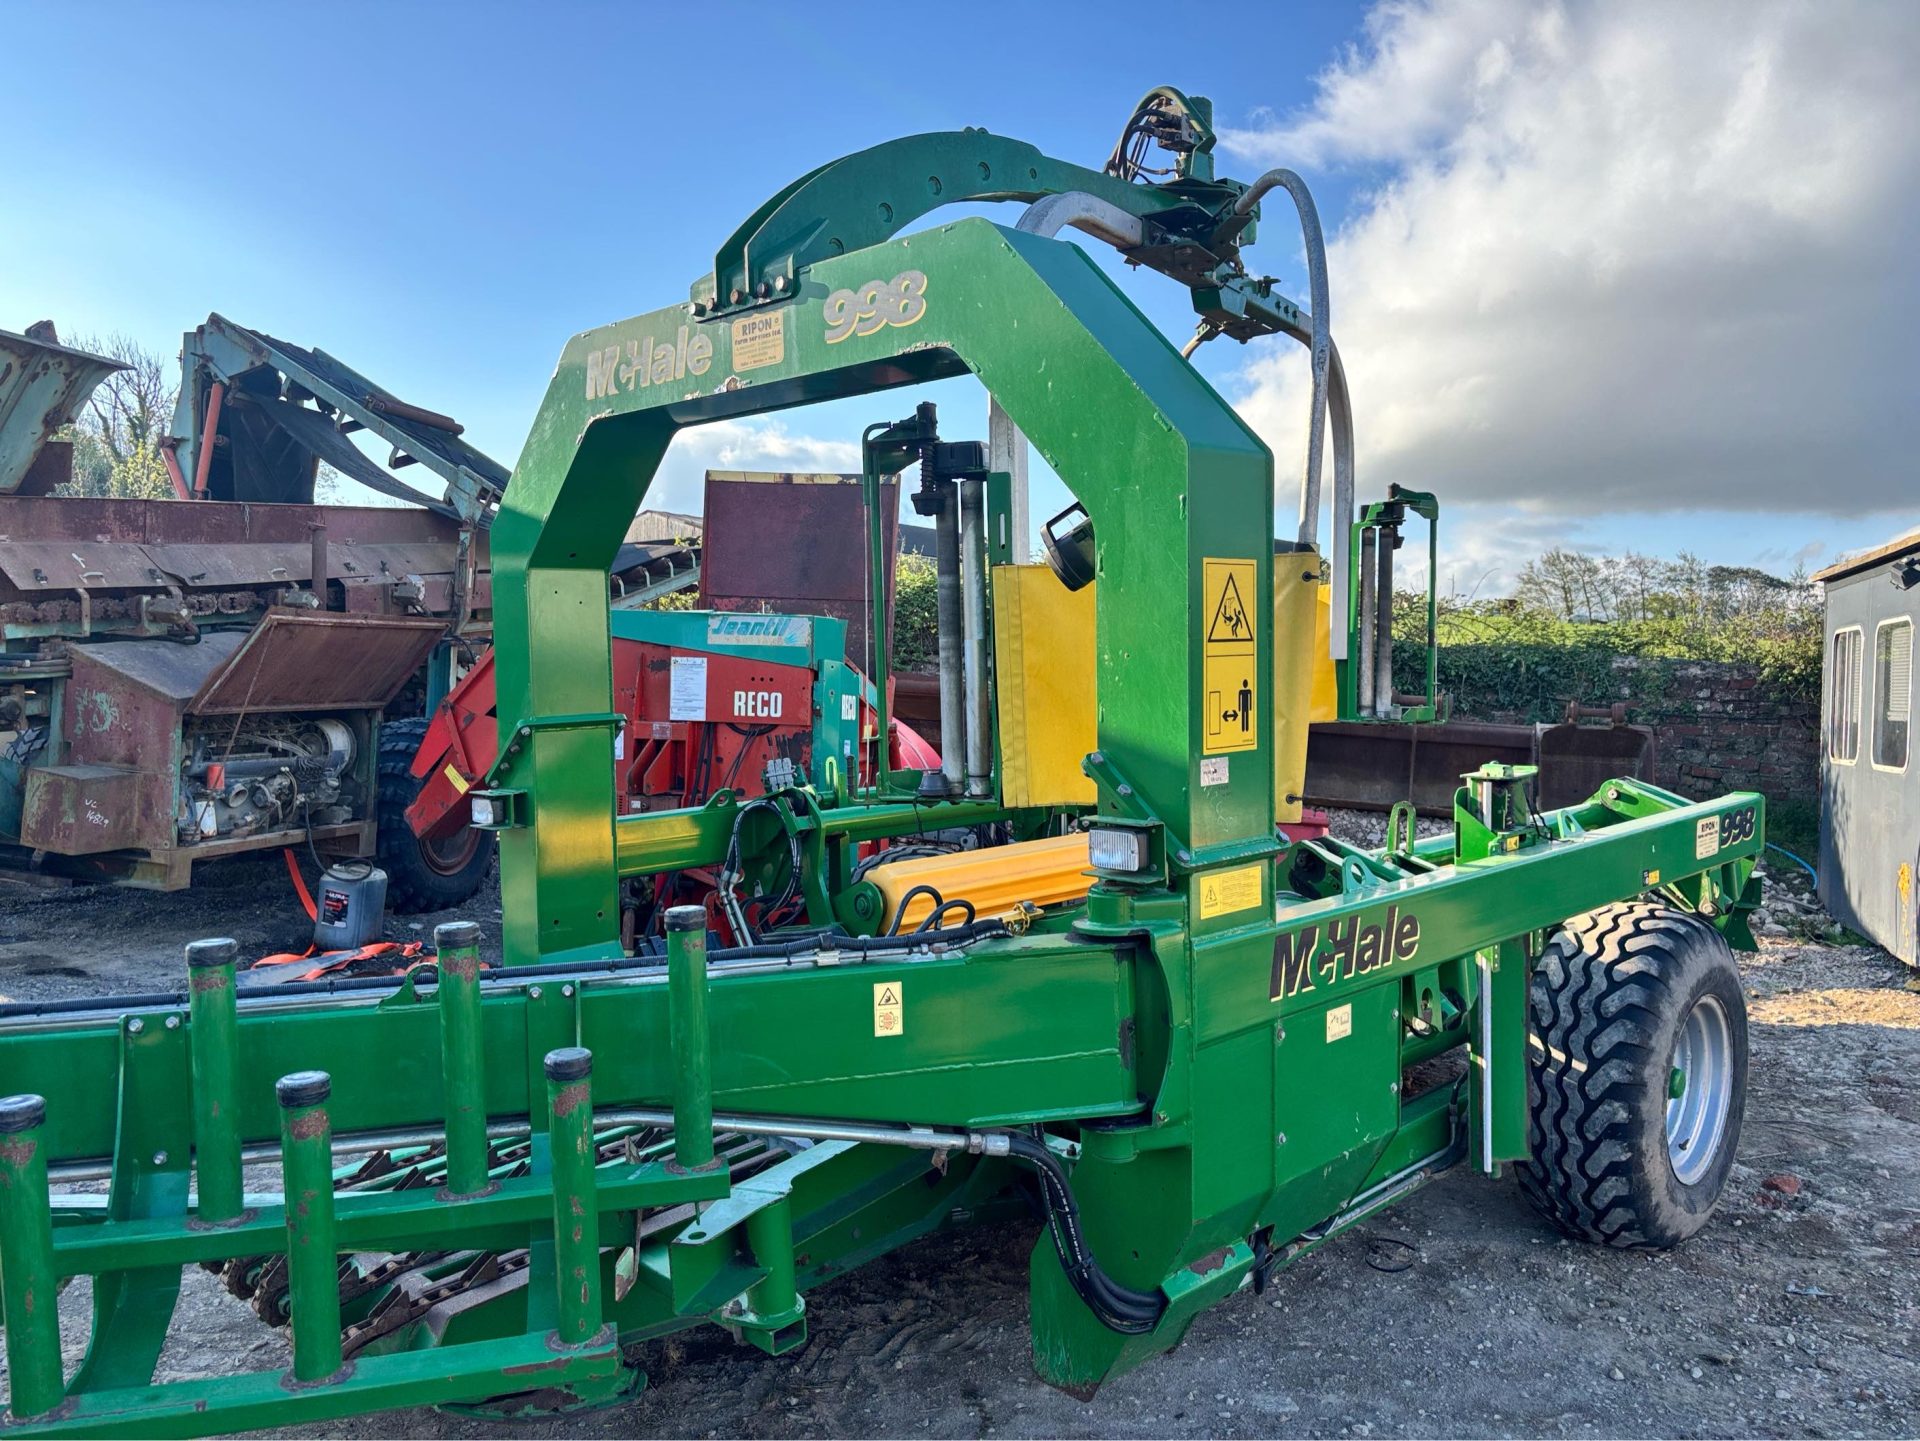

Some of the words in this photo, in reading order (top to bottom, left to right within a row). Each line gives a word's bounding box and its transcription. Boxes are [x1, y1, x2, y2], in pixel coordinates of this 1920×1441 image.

[741, 317, 772, 337] RIPON
[823, 270, 927, 344] 998
[586, 325, 713, 400] McHale
[733, 691, 783, 718] RECO
[1720, 806, 1756, 848] 998
[1269, 904, 1420, 1003] McHale
